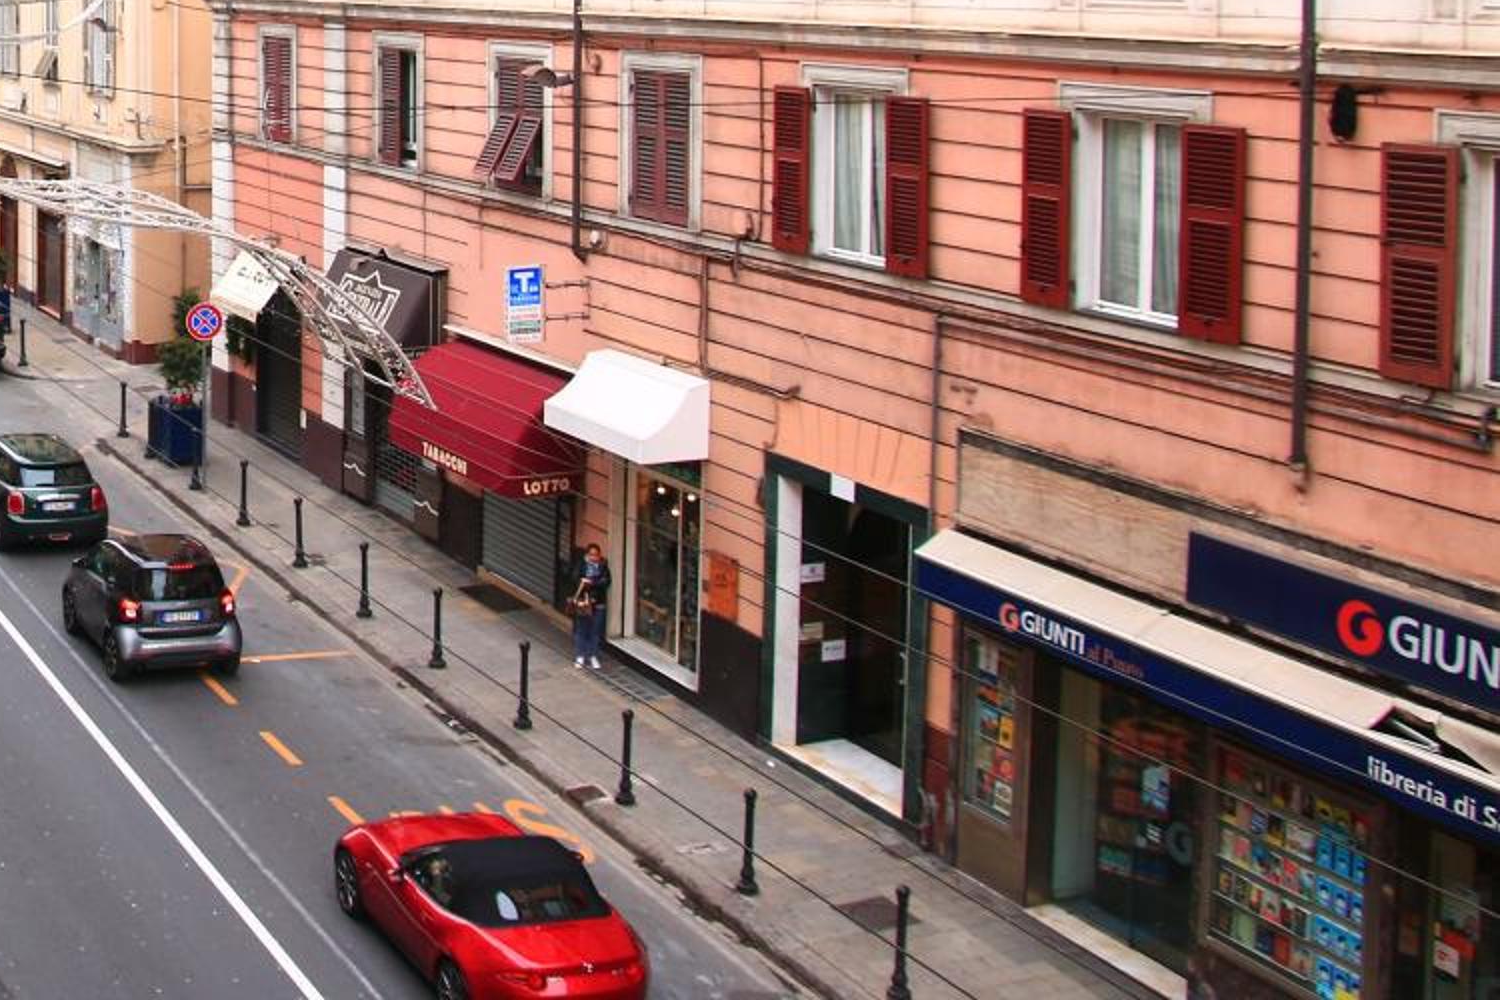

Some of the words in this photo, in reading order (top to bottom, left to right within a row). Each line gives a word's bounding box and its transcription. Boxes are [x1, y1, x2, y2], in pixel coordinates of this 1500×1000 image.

[513, 271, 535, 293] T
[422, 441, 468, 475] TABACCHI
[523, 478, 570, 495] LOTTO
[1021, 610, 1086, 655] GIUNTI
[1367, 755, 1448, 809] libreria
[1453, 795, 1478, 822] di
[1483, 805, 1500, 832] S
